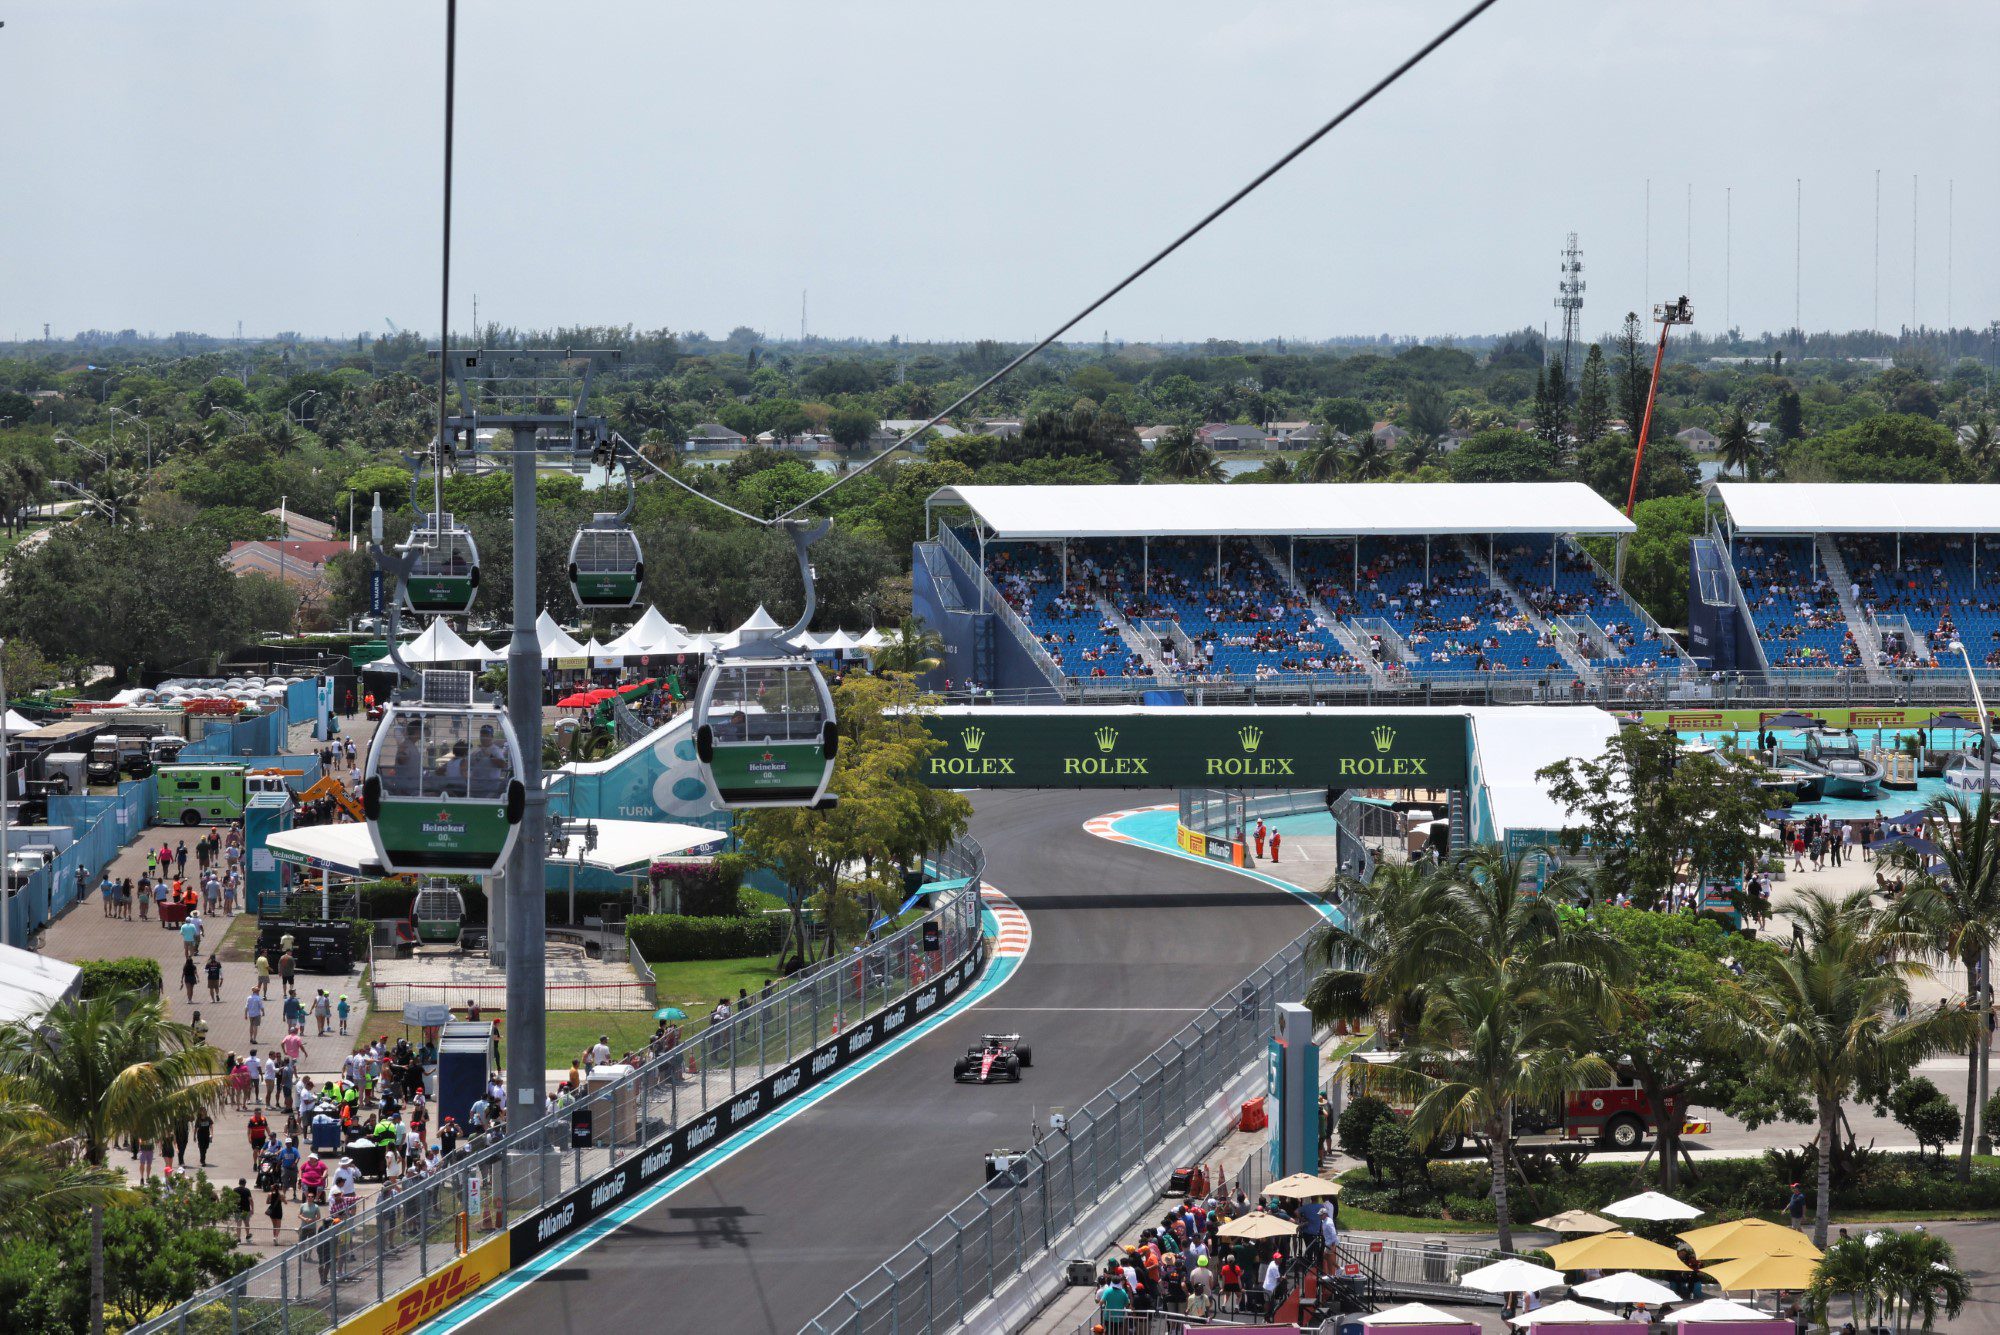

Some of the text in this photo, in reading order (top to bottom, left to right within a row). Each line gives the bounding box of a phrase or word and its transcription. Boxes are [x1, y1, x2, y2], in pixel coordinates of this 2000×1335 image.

[1669, 714, 1723, 728] PIRELLI
[814, 746, 820, 754] 7
[749, 763, 786, 771] Heineken
[929, 758, 1015, 775] ROLEX
[1064, 758, 1149, 775] ROLEX
[1206, 758, 1294, 775] ROLEX
[1339, 758, 1427, 775] ROLEX
[497, 808, 505, 818] 3
[618, 806, 653, 817] TURN
[422, 823, 465, 833] Heineken
[273, 850, 304, 862] Heineken
[849, 1024, 874, 1054] #MiamiGP
[812, 1045, 838, 1076] #MiamiGP
[1270, 1052, 1277, 1095] 5
[773, 1067, 801, 1099] #MiamiGP
[731, 1090, 760, 1124] #MiamiGP
[687, 1116, 717, 1151] #MiamiGP
[641, 1142, 673, 1179] #MiamiGP
[591, 1171, 626, 1210] #MiamiGP
[537, 1202, 575, 1242] #MiamiGP
[397, 1264, 467, 1330] DHL
